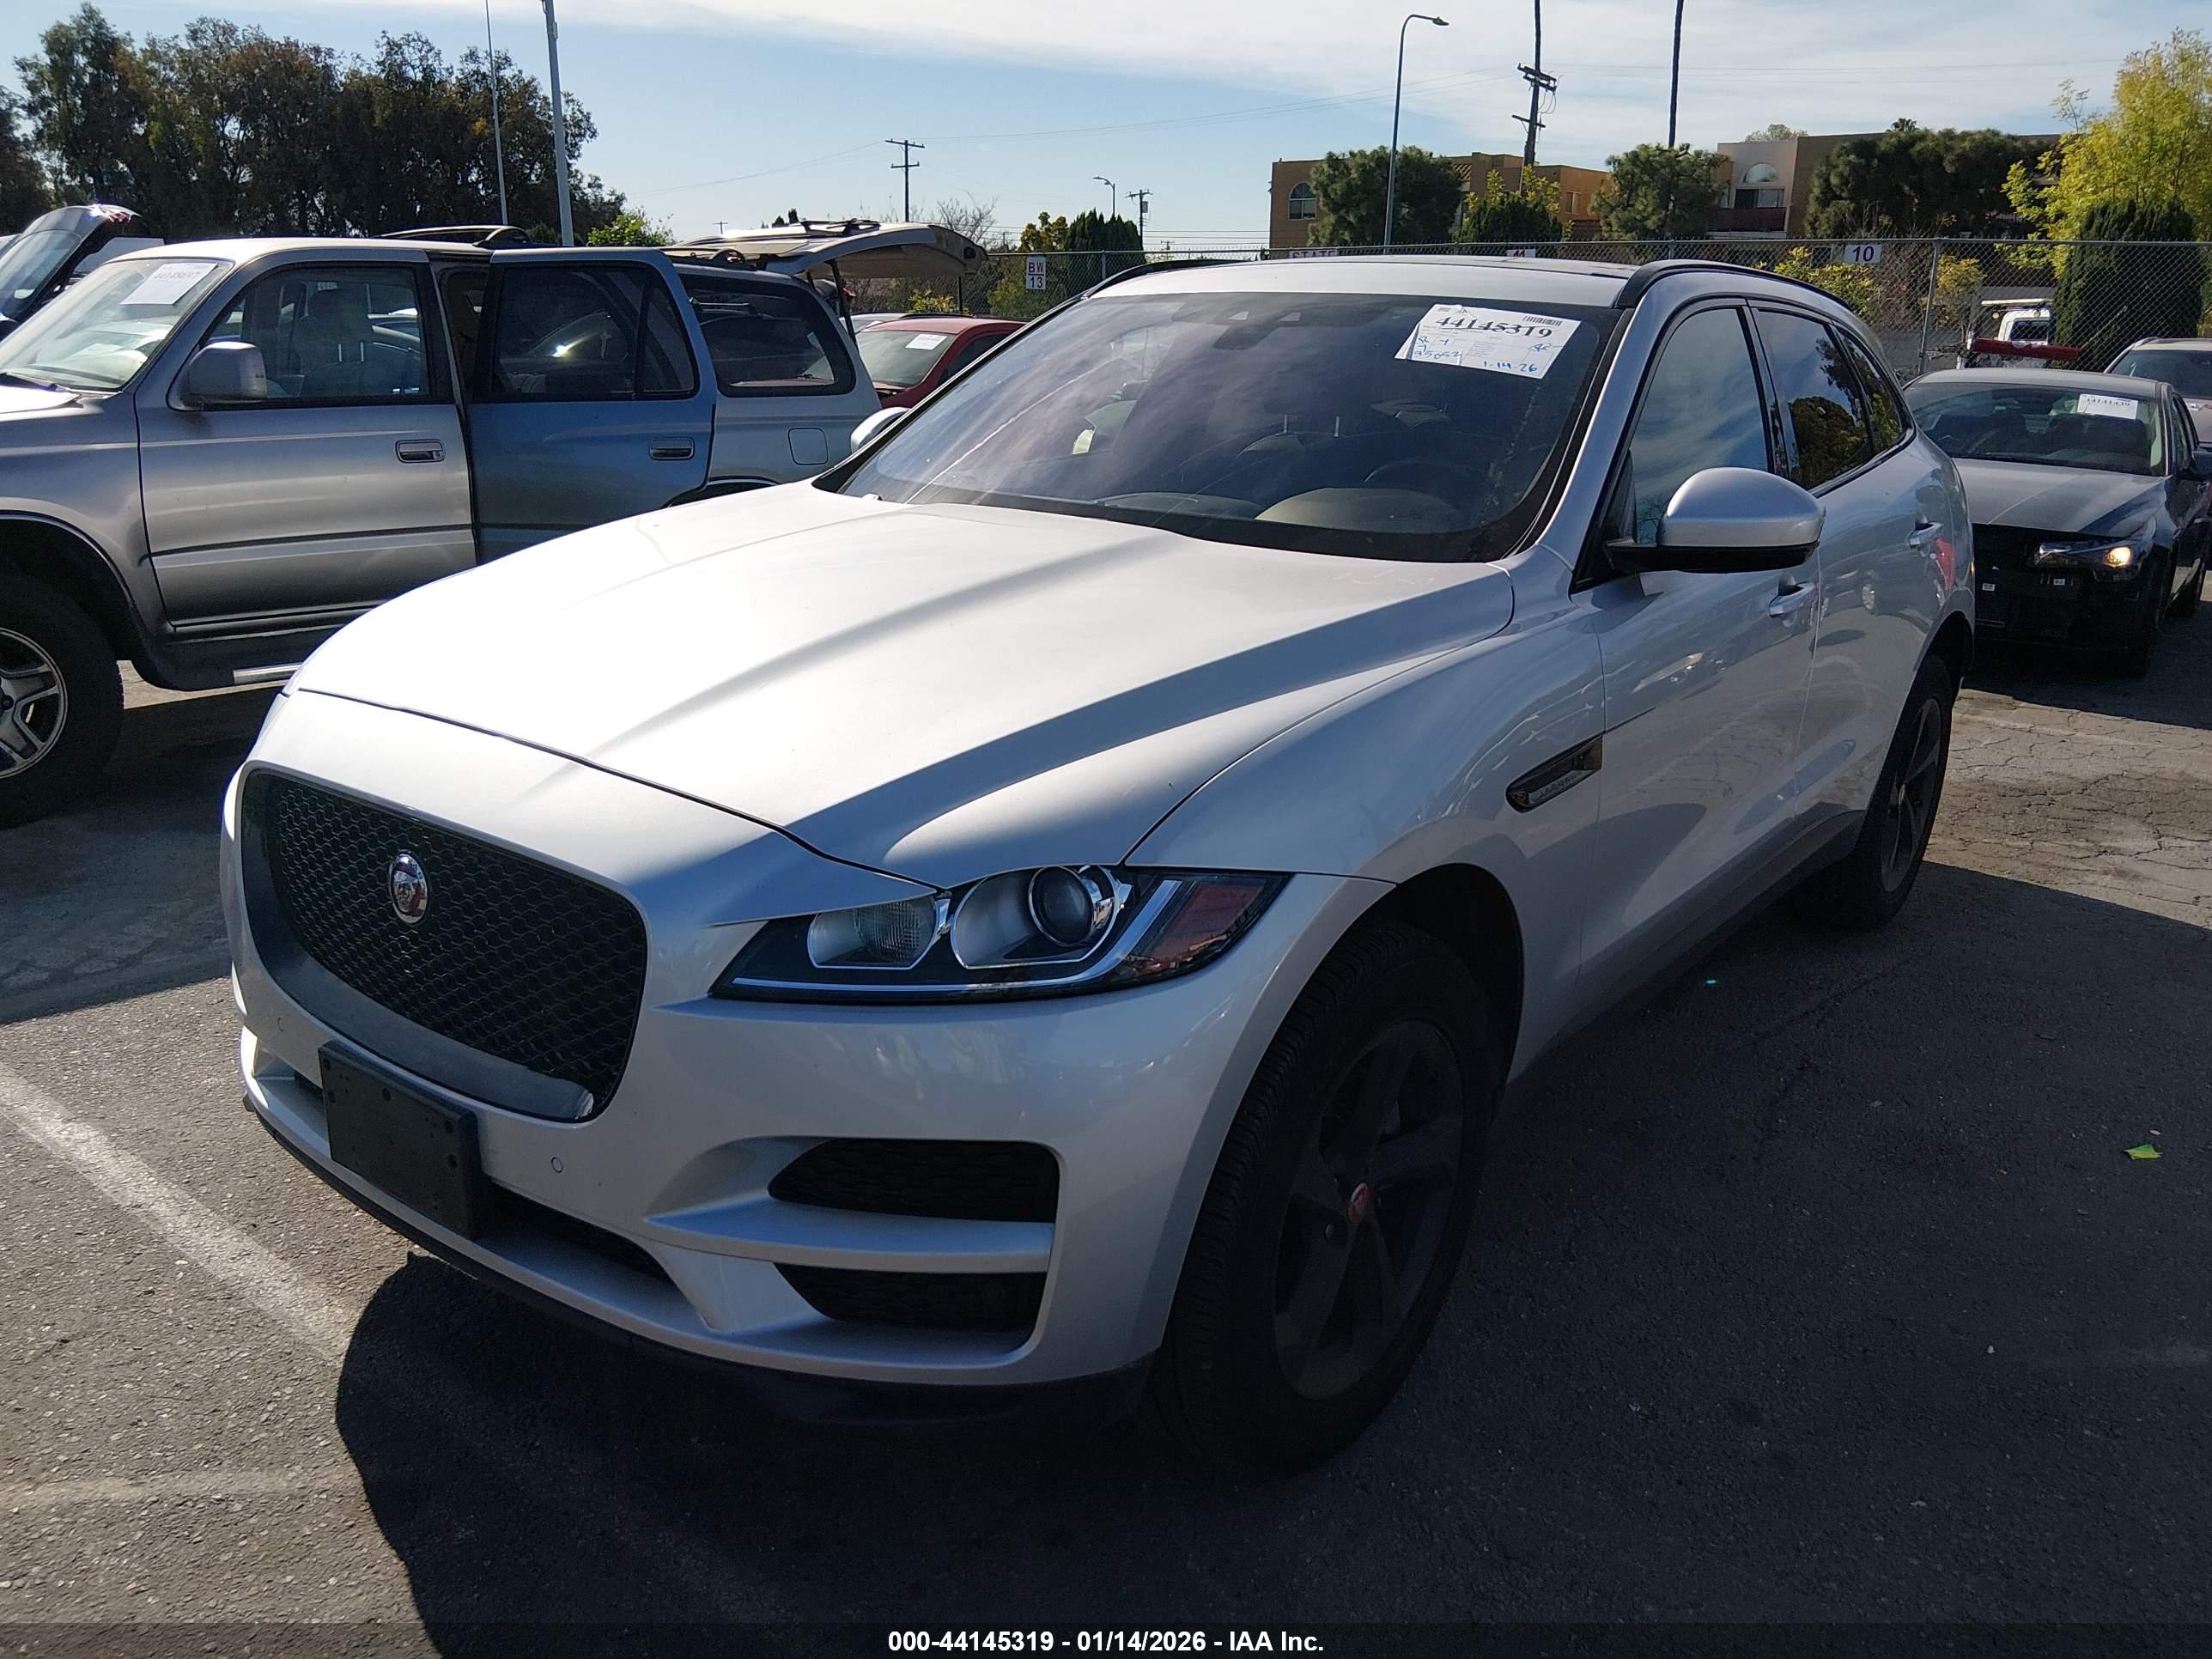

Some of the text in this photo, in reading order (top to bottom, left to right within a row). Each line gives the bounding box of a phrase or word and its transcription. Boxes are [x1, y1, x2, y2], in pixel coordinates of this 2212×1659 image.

[1853, 246, 1875, 262] 10
[1029, 262, 1044, 273] BW
[1030, 276, 1043, 289] 13
[1436, 316, 1553, 338] 44145319
